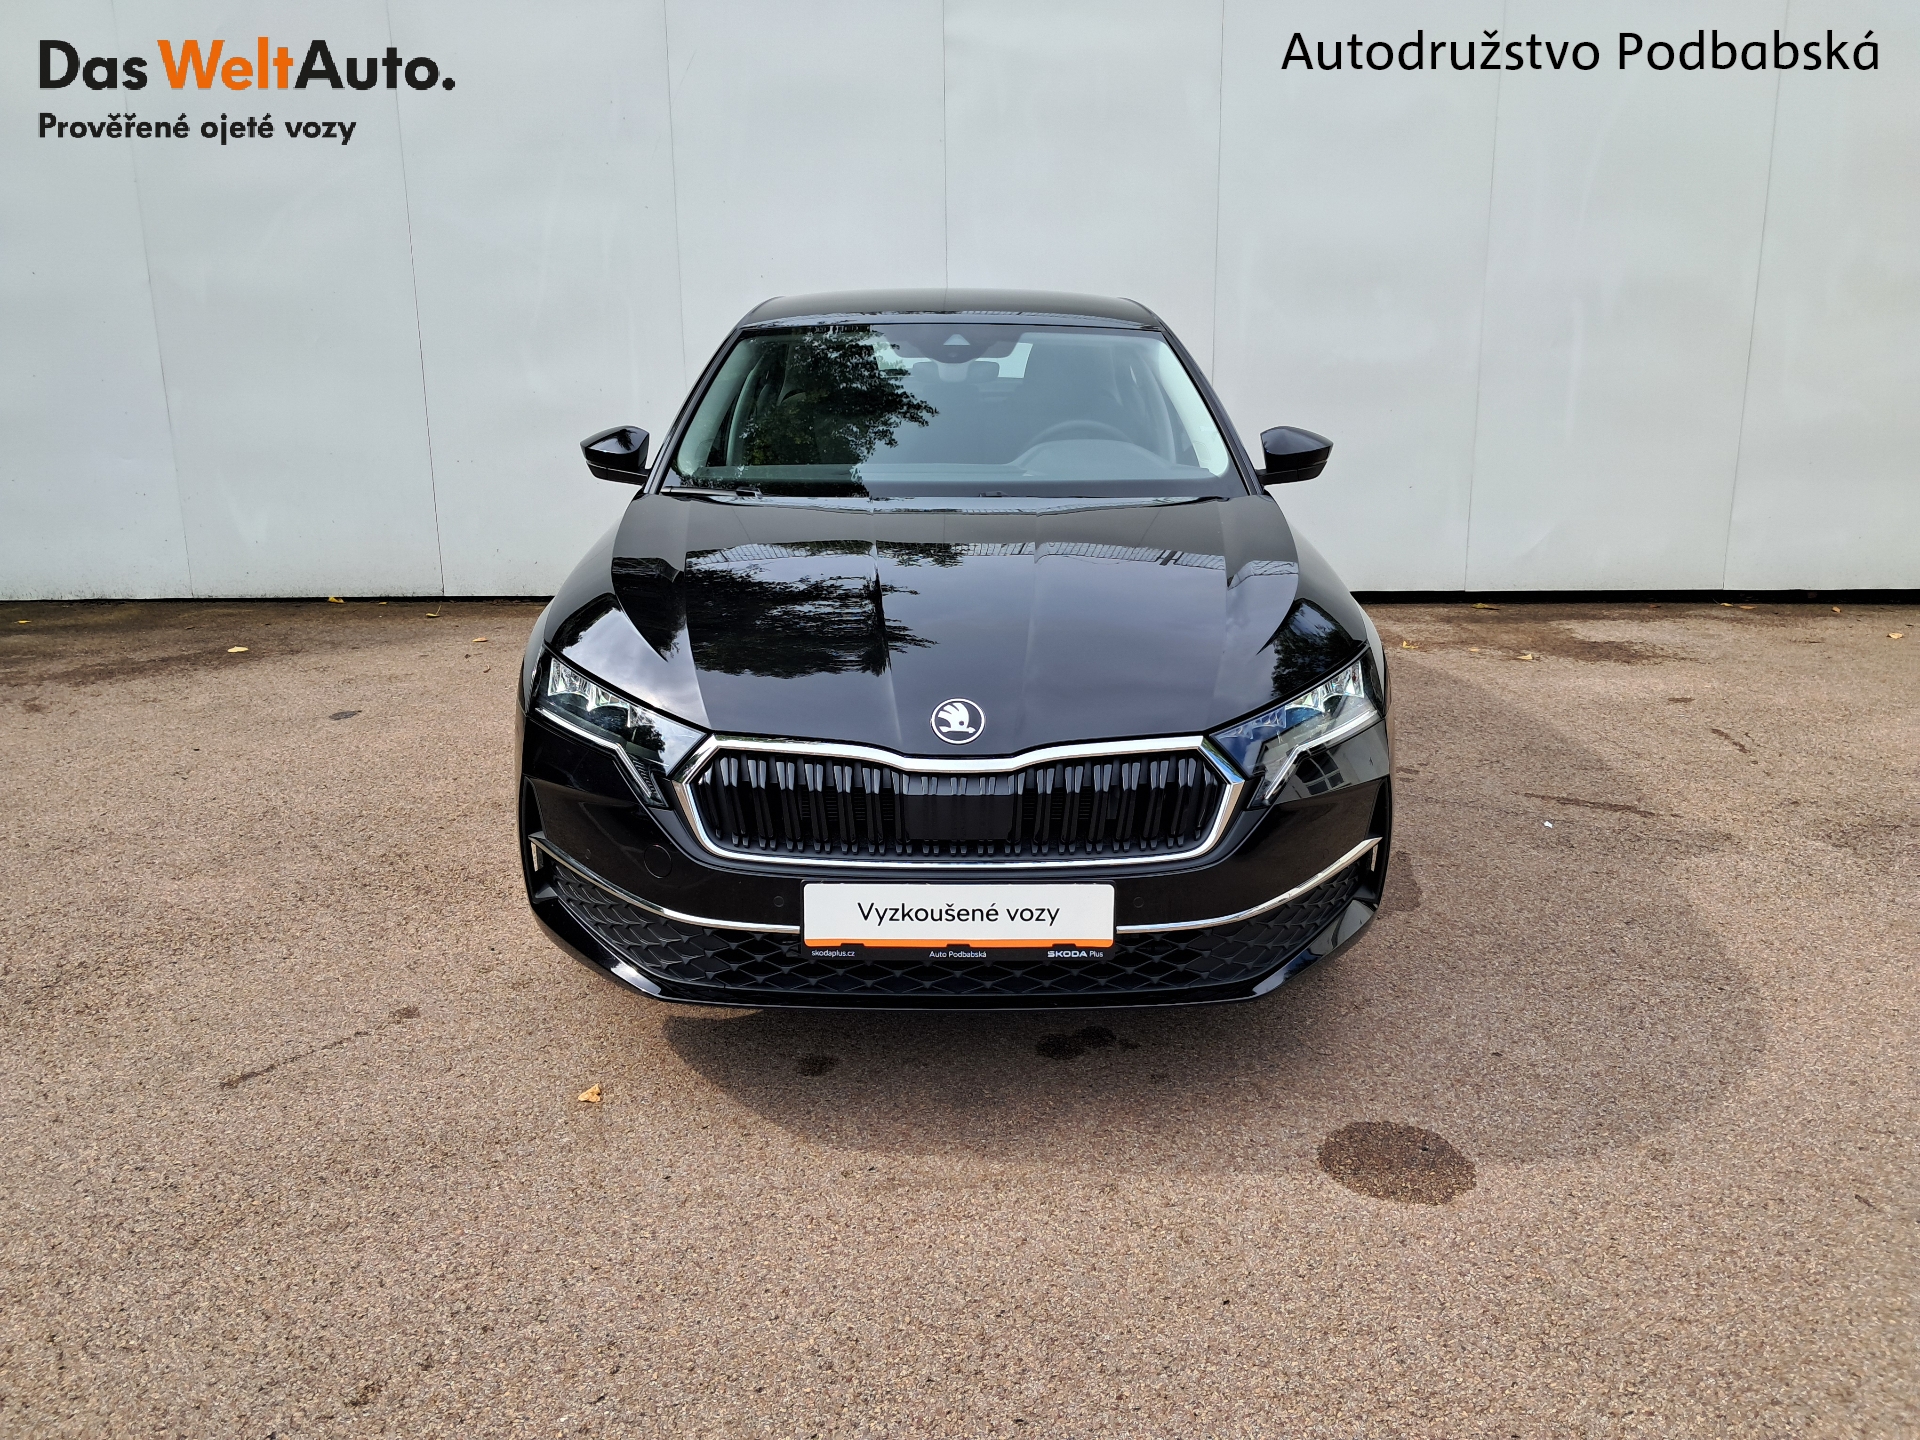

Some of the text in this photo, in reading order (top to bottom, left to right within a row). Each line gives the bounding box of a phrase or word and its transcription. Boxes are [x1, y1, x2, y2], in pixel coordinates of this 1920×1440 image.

[857, 902, 1060, 926] Vyzkoušené vozy
[811, 949, 855, 957] skodaplus.cz
[1089, 950, 1104, 958] Plus
